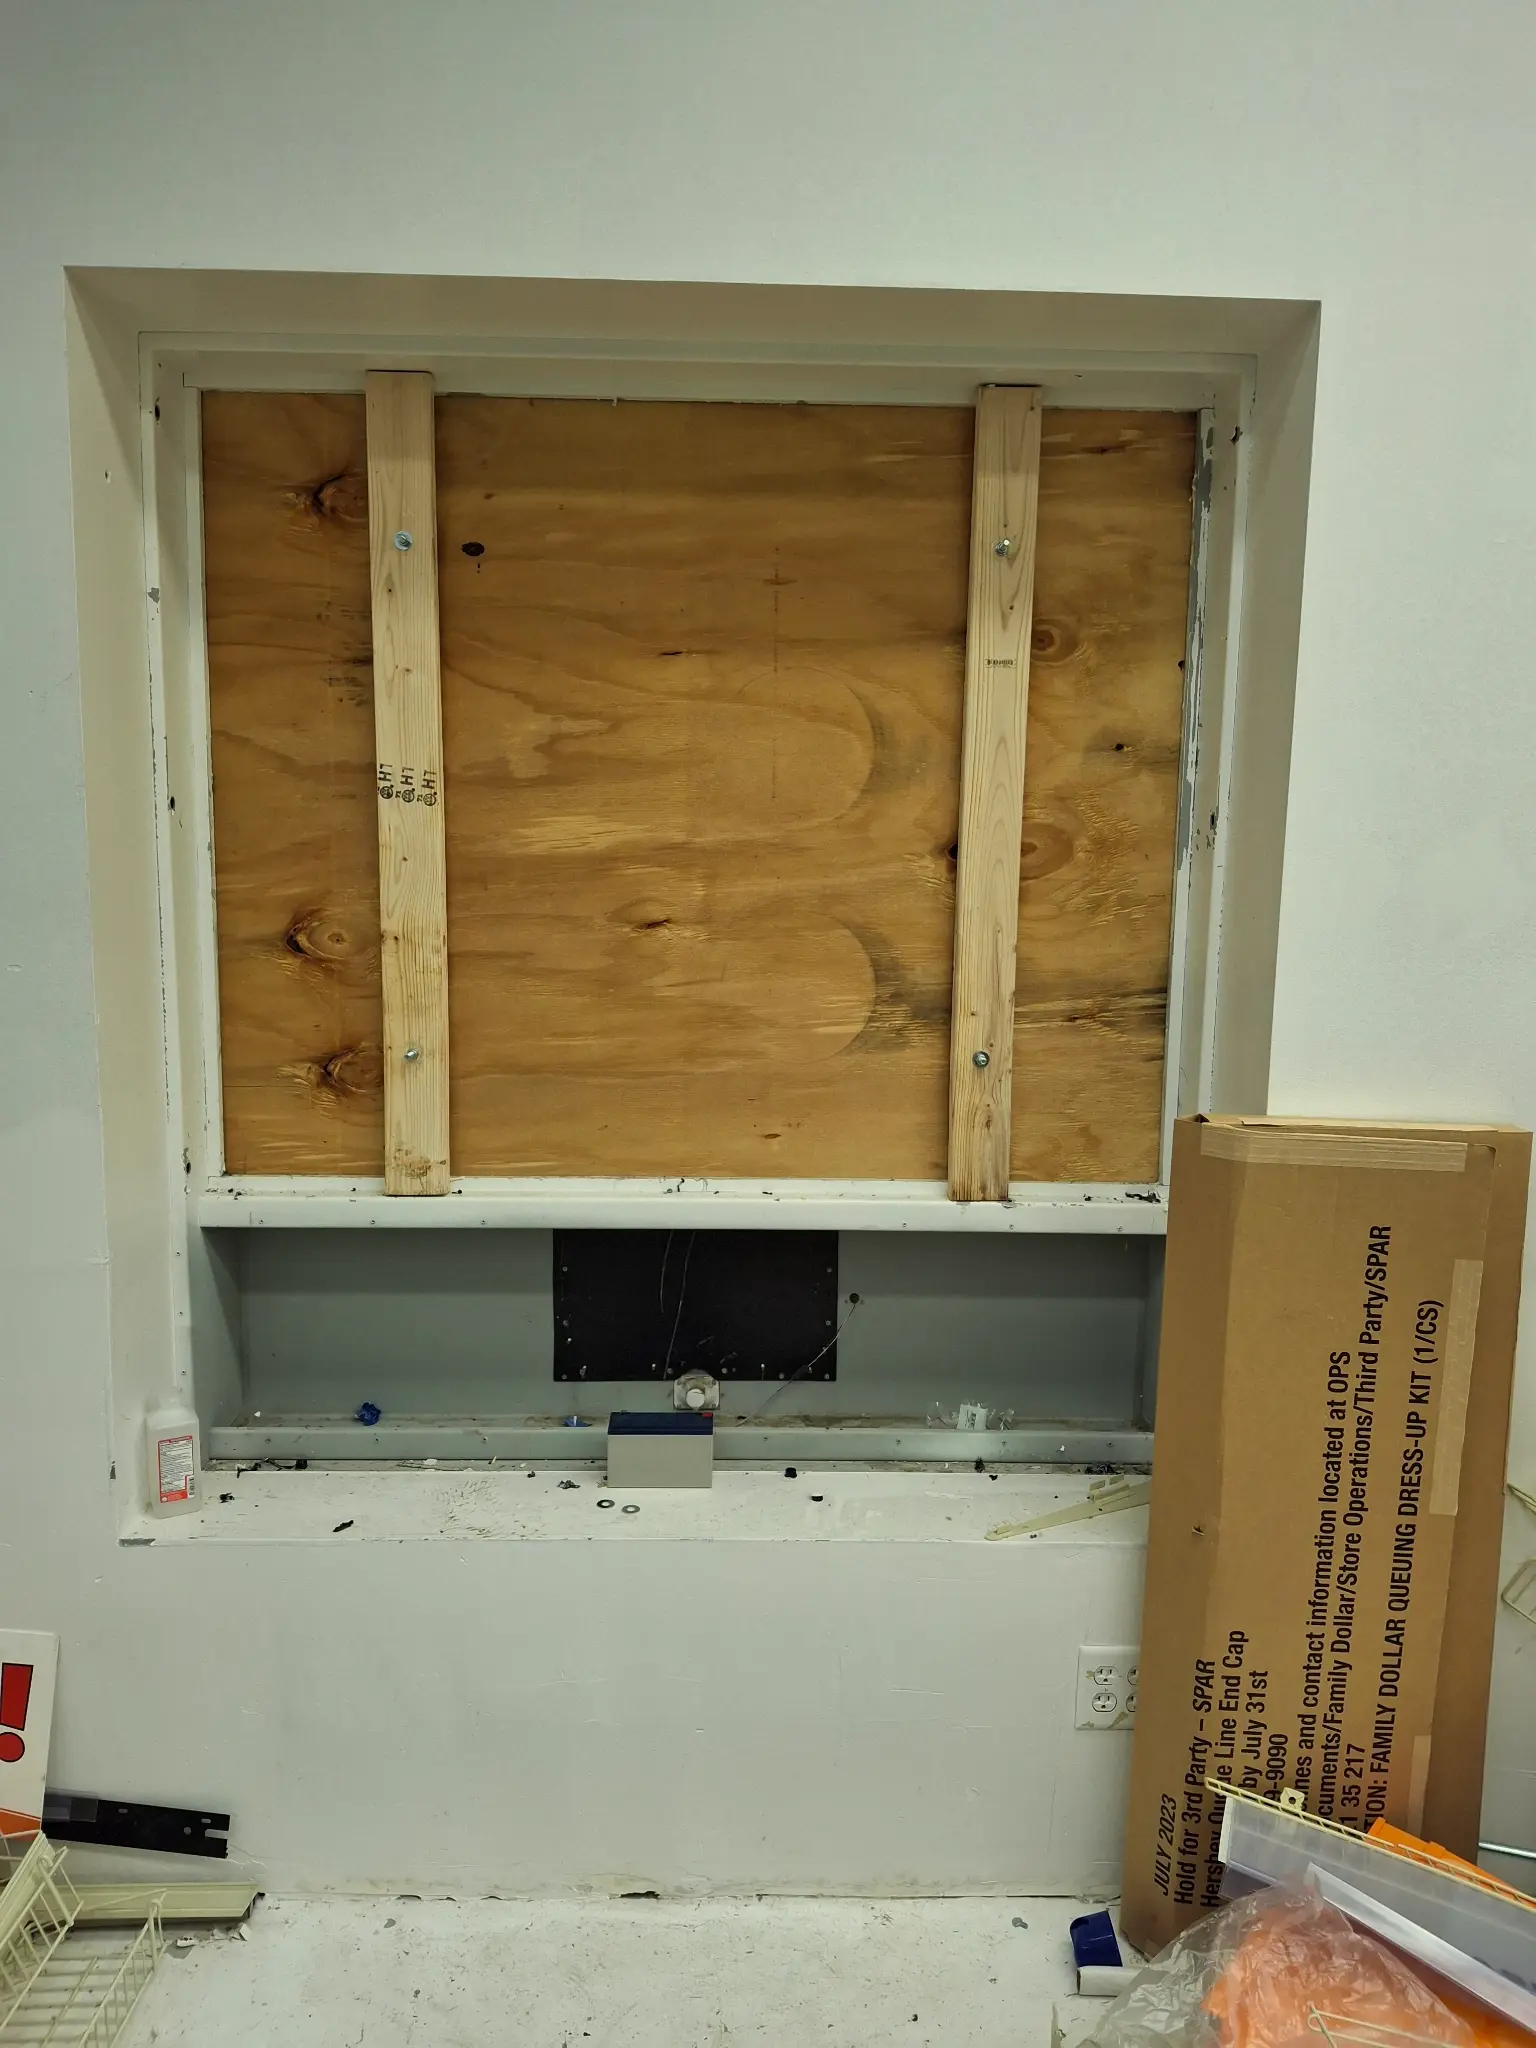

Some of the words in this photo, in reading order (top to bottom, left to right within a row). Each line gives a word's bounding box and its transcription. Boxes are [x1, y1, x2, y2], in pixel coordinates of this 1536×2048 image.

[1358, 1225, 1392, 1345] Party/SPAR
[1413, 1300, 1444, 1364] (1/CS)
[1327, 1351, 1351, 1394] OPS
[1408, 1371, 1431, 1404] KIT
[1326, 1399, 1347, 1420] at
[1342, 1351, 1379, 1526] Operations/Third
[1397, 1411, 1427, 1516] DRESS-UP
[1317, 1427, 1345, 1502] located
[1306, 1509, 1337, 1626] information
[1330, 1532, 1362, 1653] Dollar/Store
[1387, 1523, 1417, 1611] QUEUING
[1222, 1630, 1249, 1669] Cap
[1302, 1632, 1326, 1708] contact
[1378, 1618, 1406, 1697] DOLLAR
[1192, 1659, 1215, 1713] SPAR
[1218, 1675, 1241, 1712] End
[1245, 1670, 1268, 1713] 31st
[1214, 1718, 1237, 1759] Line
[1241, 1719, 1267, 1760] July
[1297, 1714, 1317, 1750] and
[1370, 1703, 1396, 1773] FAMILY
[1184, 1736, 1213, 1787] Party
[1238, 1766, 1263, 1789] by
[1263, 1733, 1288, 1803] 9-9090
[1344, 1743, 1365, 1778] 217
[1158, 1793, 1176, 1846] 2023
[1181, 1791, 1203, 1823] 3rd
[1341, 1784, 1361, 1808] 35
[1363, 1780, 1387, 1834] TION:
[1177, 1828, 1199, 1856] for
[1154, 1844, 1172, 1896] JULY
[1173, 1860, 1197, 1905] Hold
